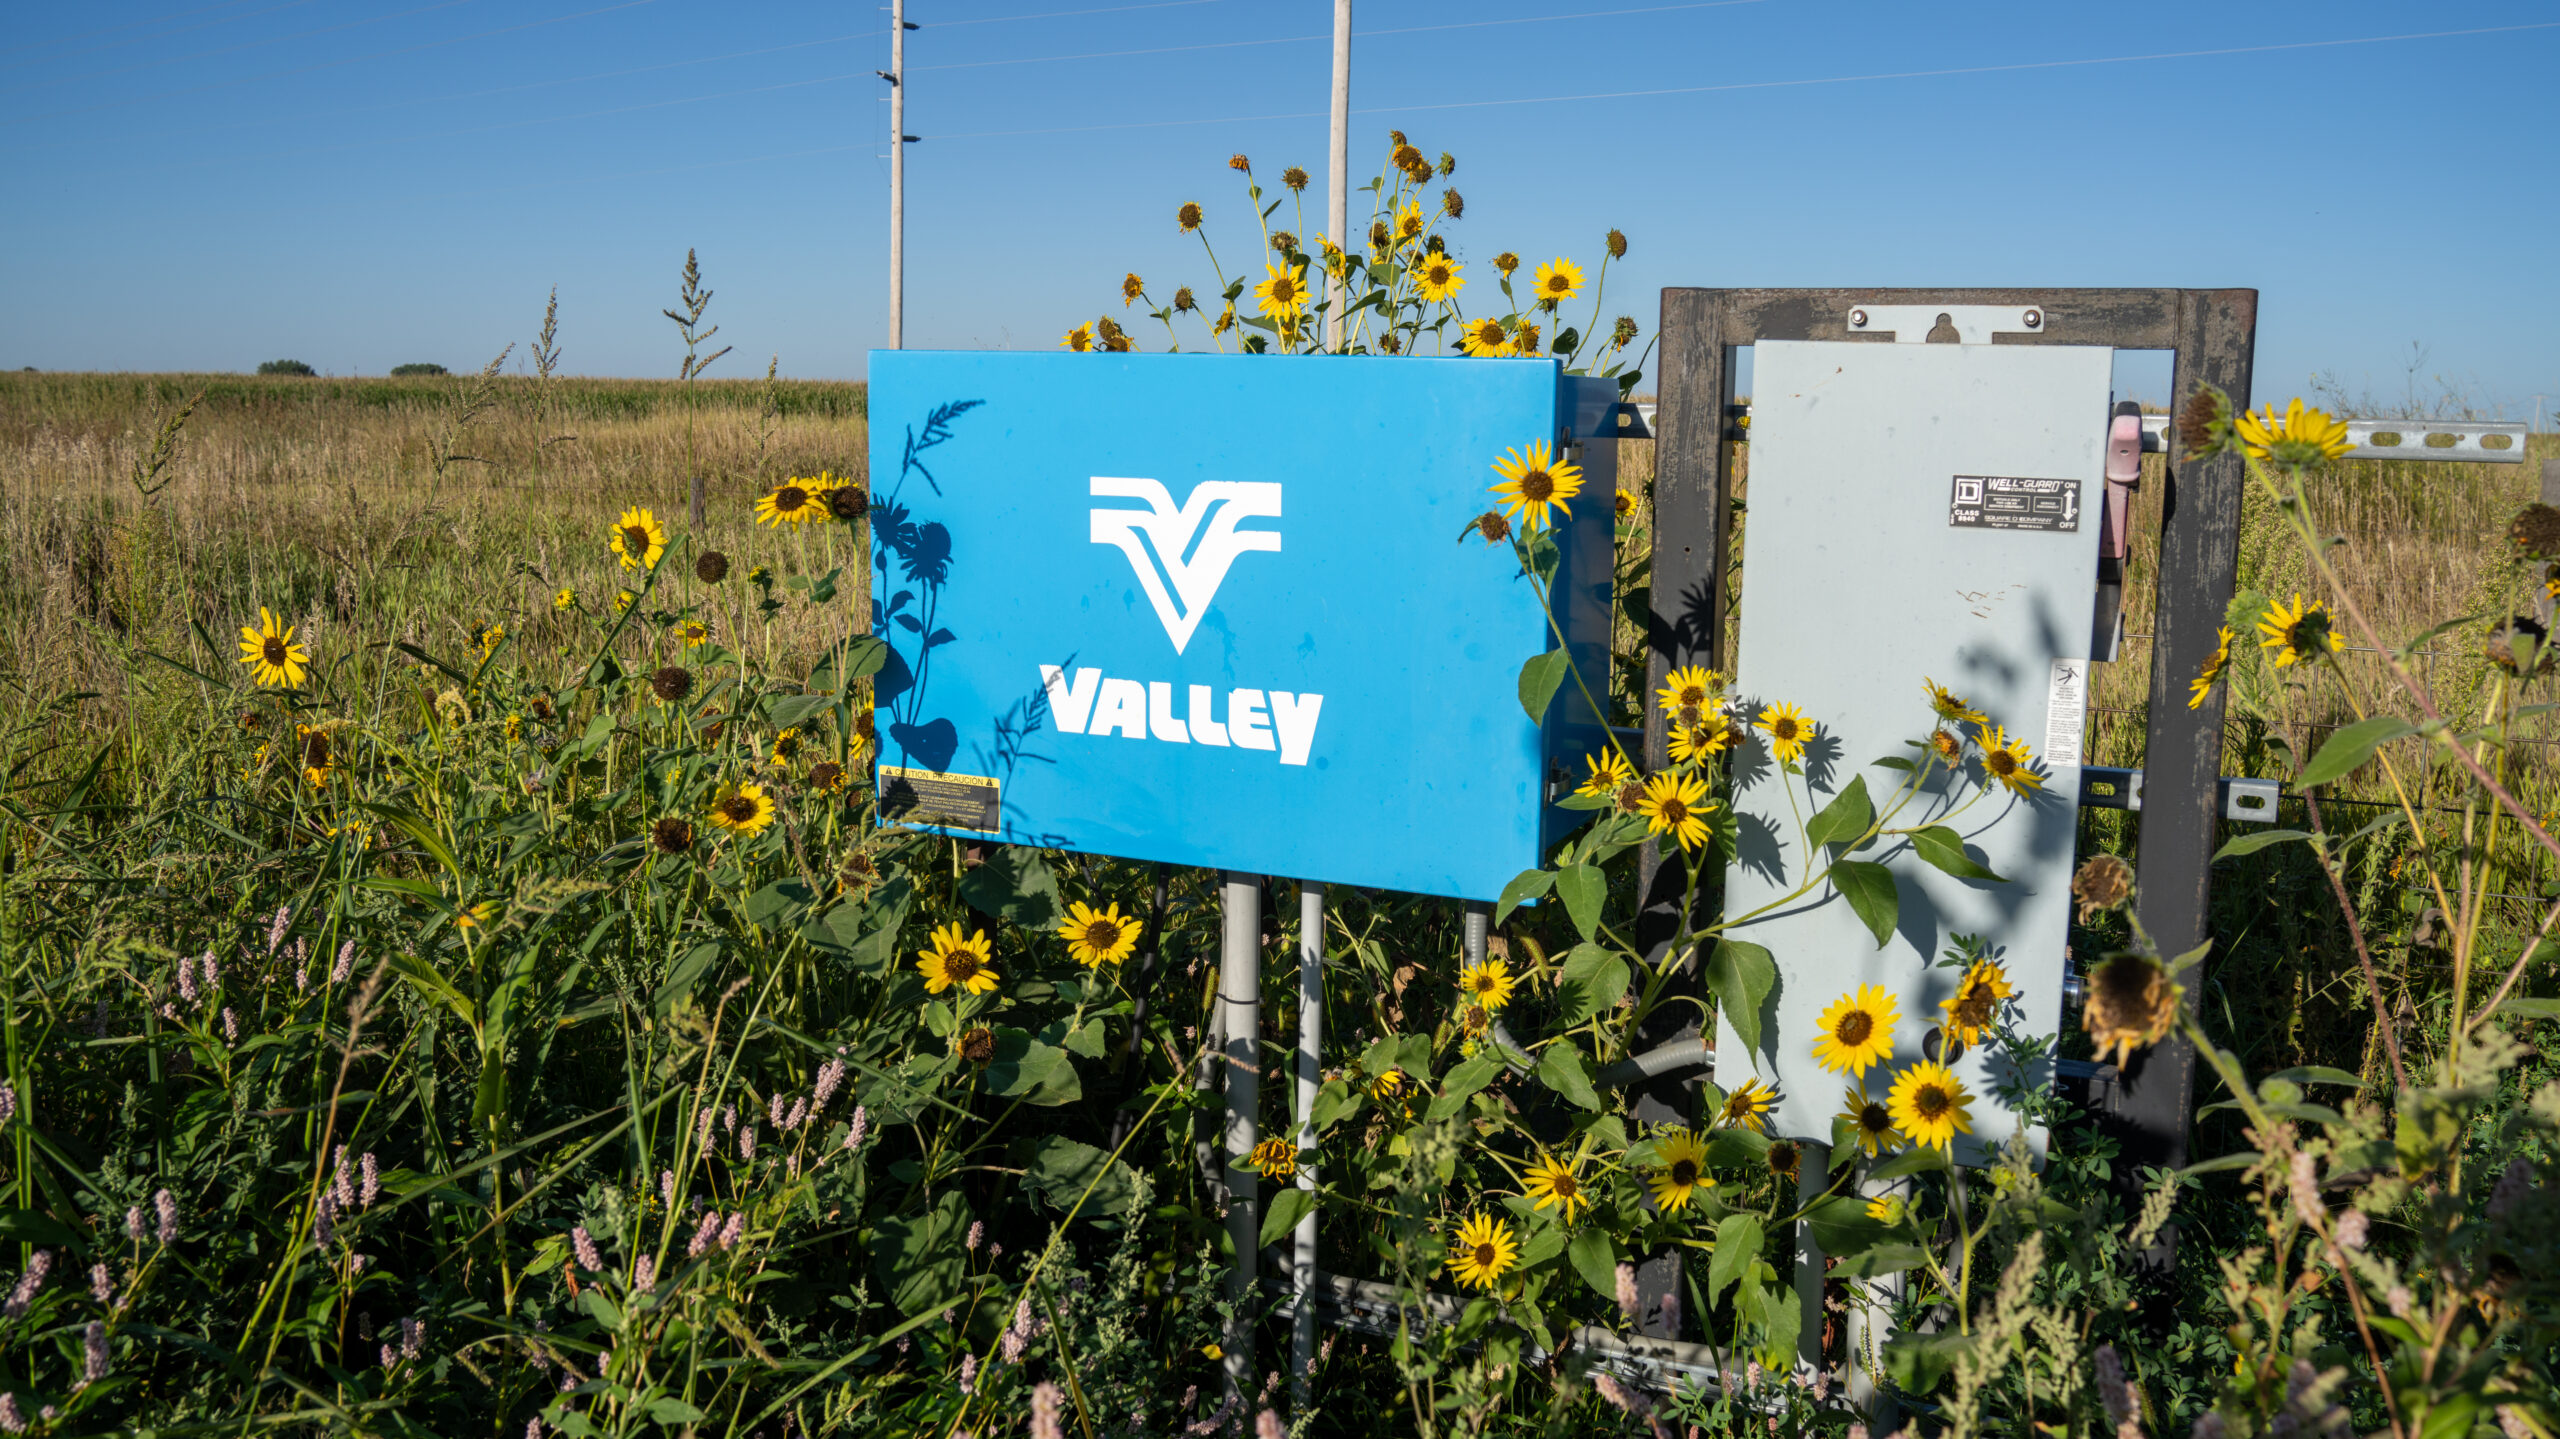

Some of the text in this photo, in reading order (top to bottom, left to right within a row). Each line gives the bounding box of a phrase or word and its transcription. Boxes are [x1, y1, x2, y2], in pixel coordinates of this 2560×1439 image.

[1987, 478, 2060, 493] WELL-GUARD
[2064, 481, 2077, 489] ON
[1954, 509, 1980, 517] CLASS
[2059, 521, 2075, 529] OFF
[1039, 664, 1324, 766] VALLEY
